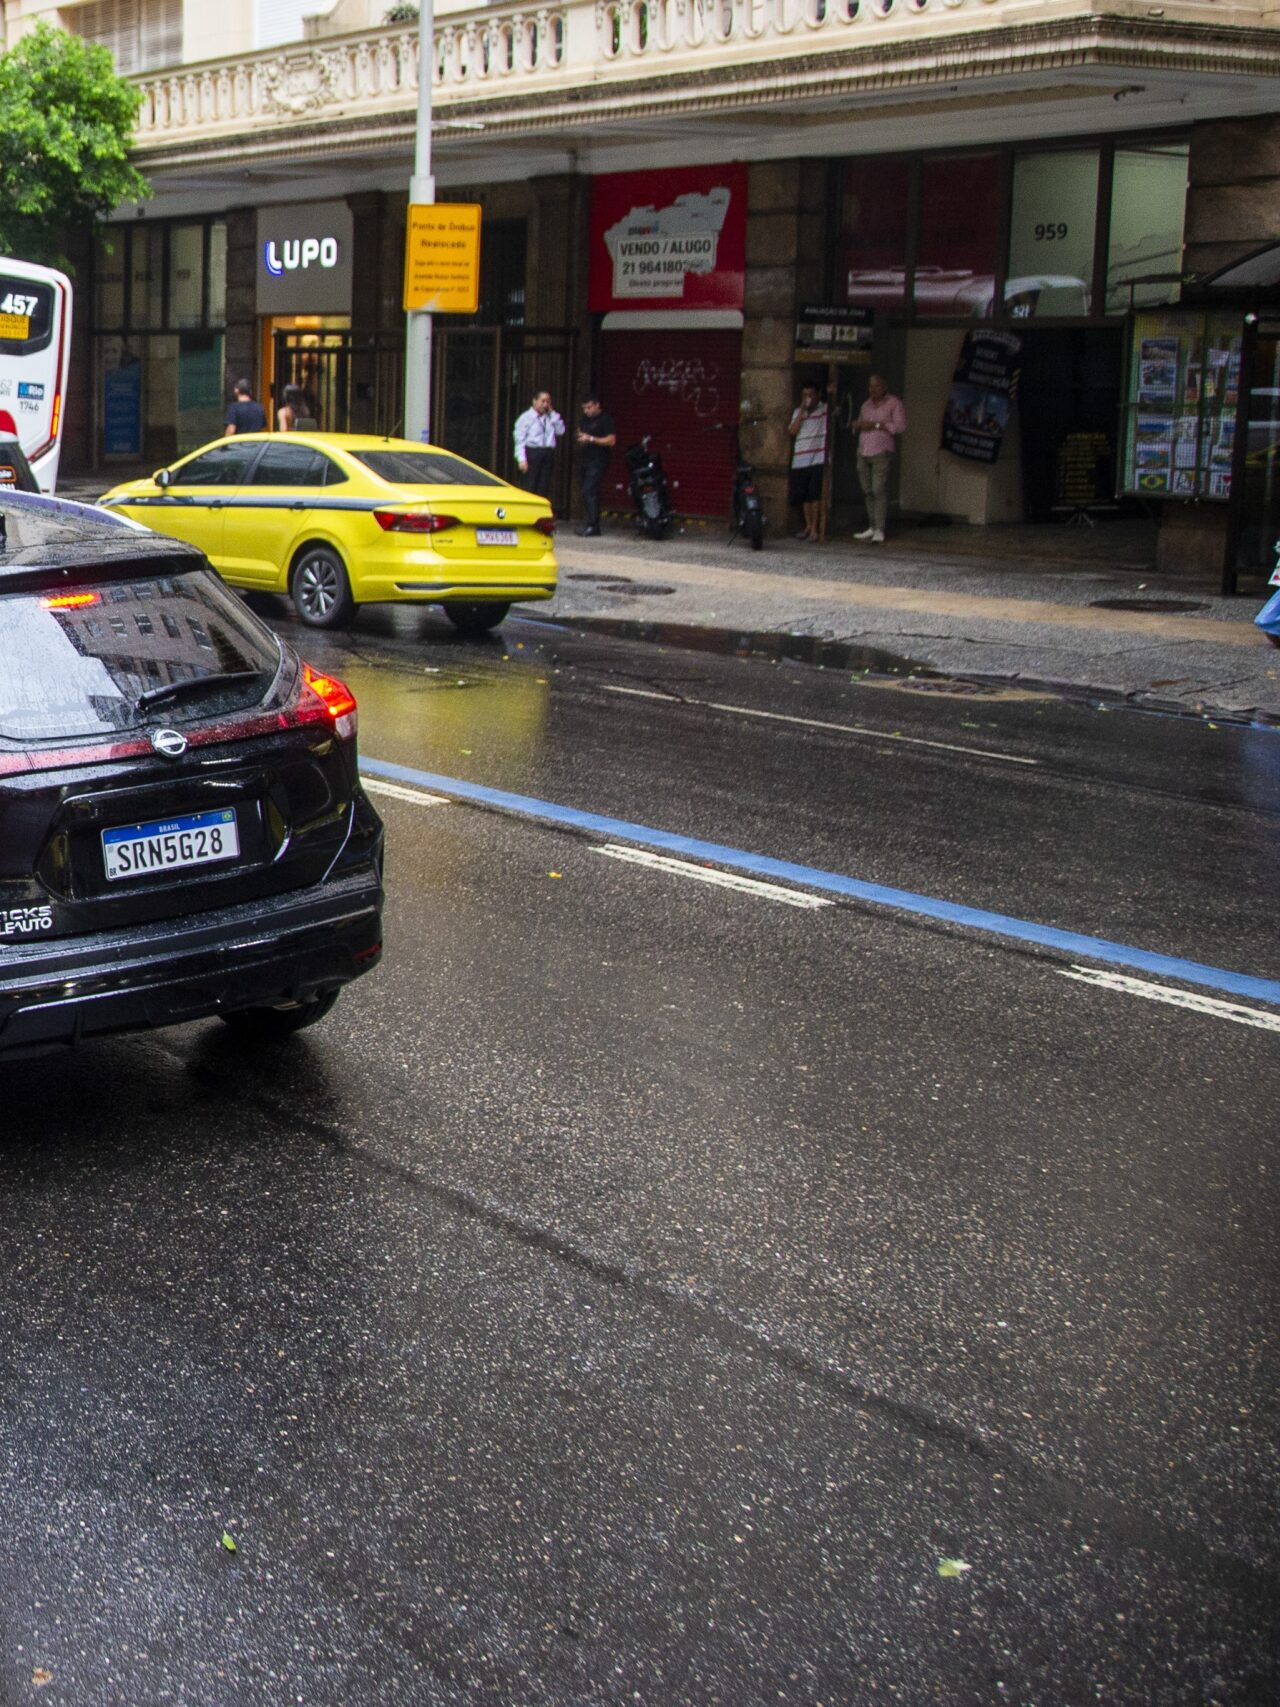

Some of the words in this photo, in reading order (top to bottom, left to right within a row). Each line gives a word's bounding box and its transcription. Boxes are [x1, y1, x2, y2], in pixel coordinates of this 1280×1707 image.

[1035, 223, 1067, 241] 959
[266, 237, 337, 274] LUPO
[620, 242, 659, 256] VENDO
[670, 239, 711, 254] ALUGO
[623, 262, 635, 275] 21
[0, 293, 38, 316] 457
[20, 401, 39, 411] 1746
[159, 823, 180, 833] BRASIL
[117, 828, 223, 872] SRN5G28
